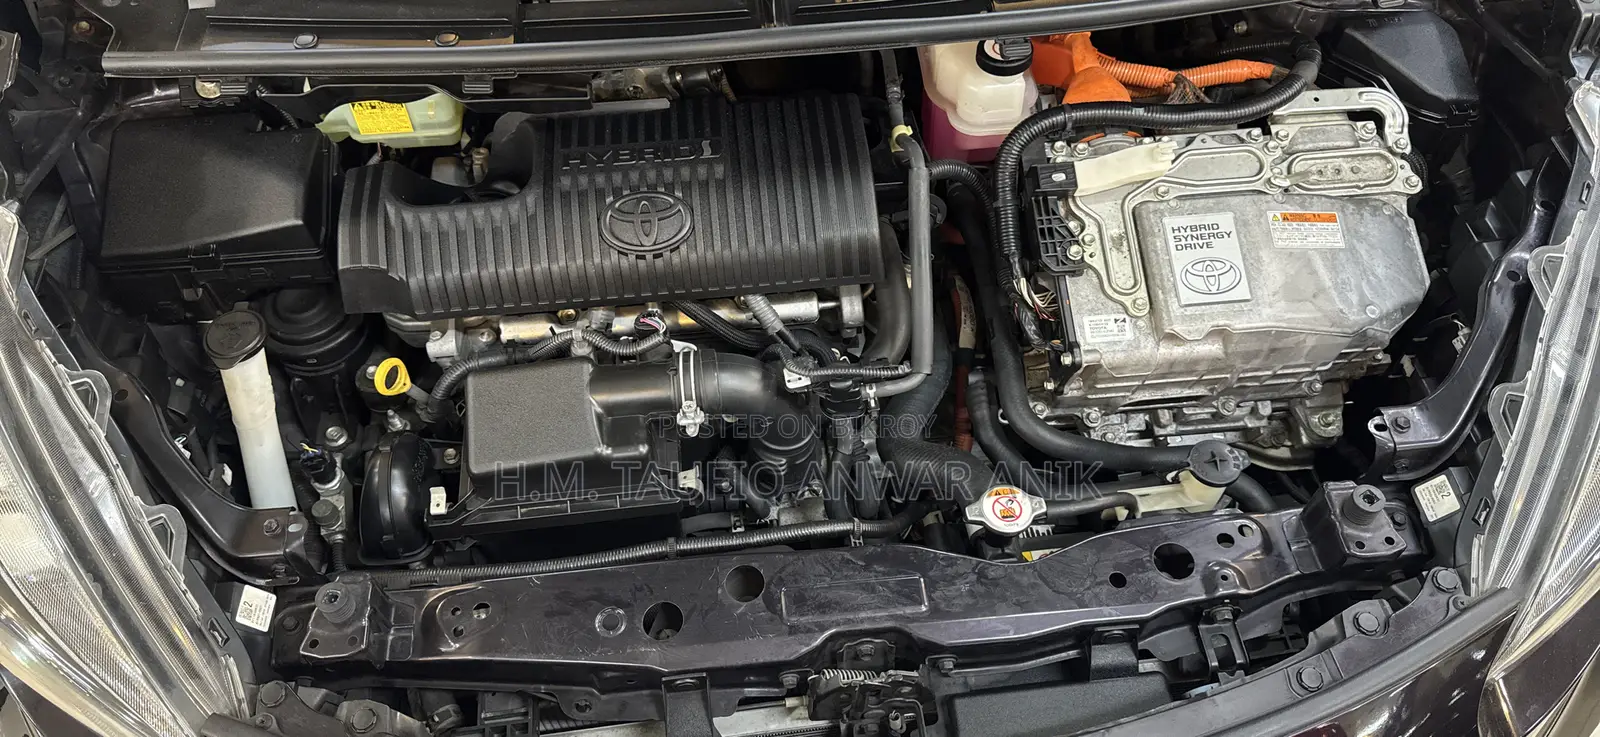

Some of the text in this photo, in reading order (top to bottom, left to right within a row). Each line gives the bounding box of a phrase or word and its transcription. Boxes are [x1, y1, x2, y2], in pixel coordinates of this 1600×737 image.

[561, 144, 697, 170] HYBRID
[1171, 222, 1220, 234] HYBRID
[1173, 230, 1233, 243] SYNERGY
[1175, 241, 1215, 252] DRIVE
